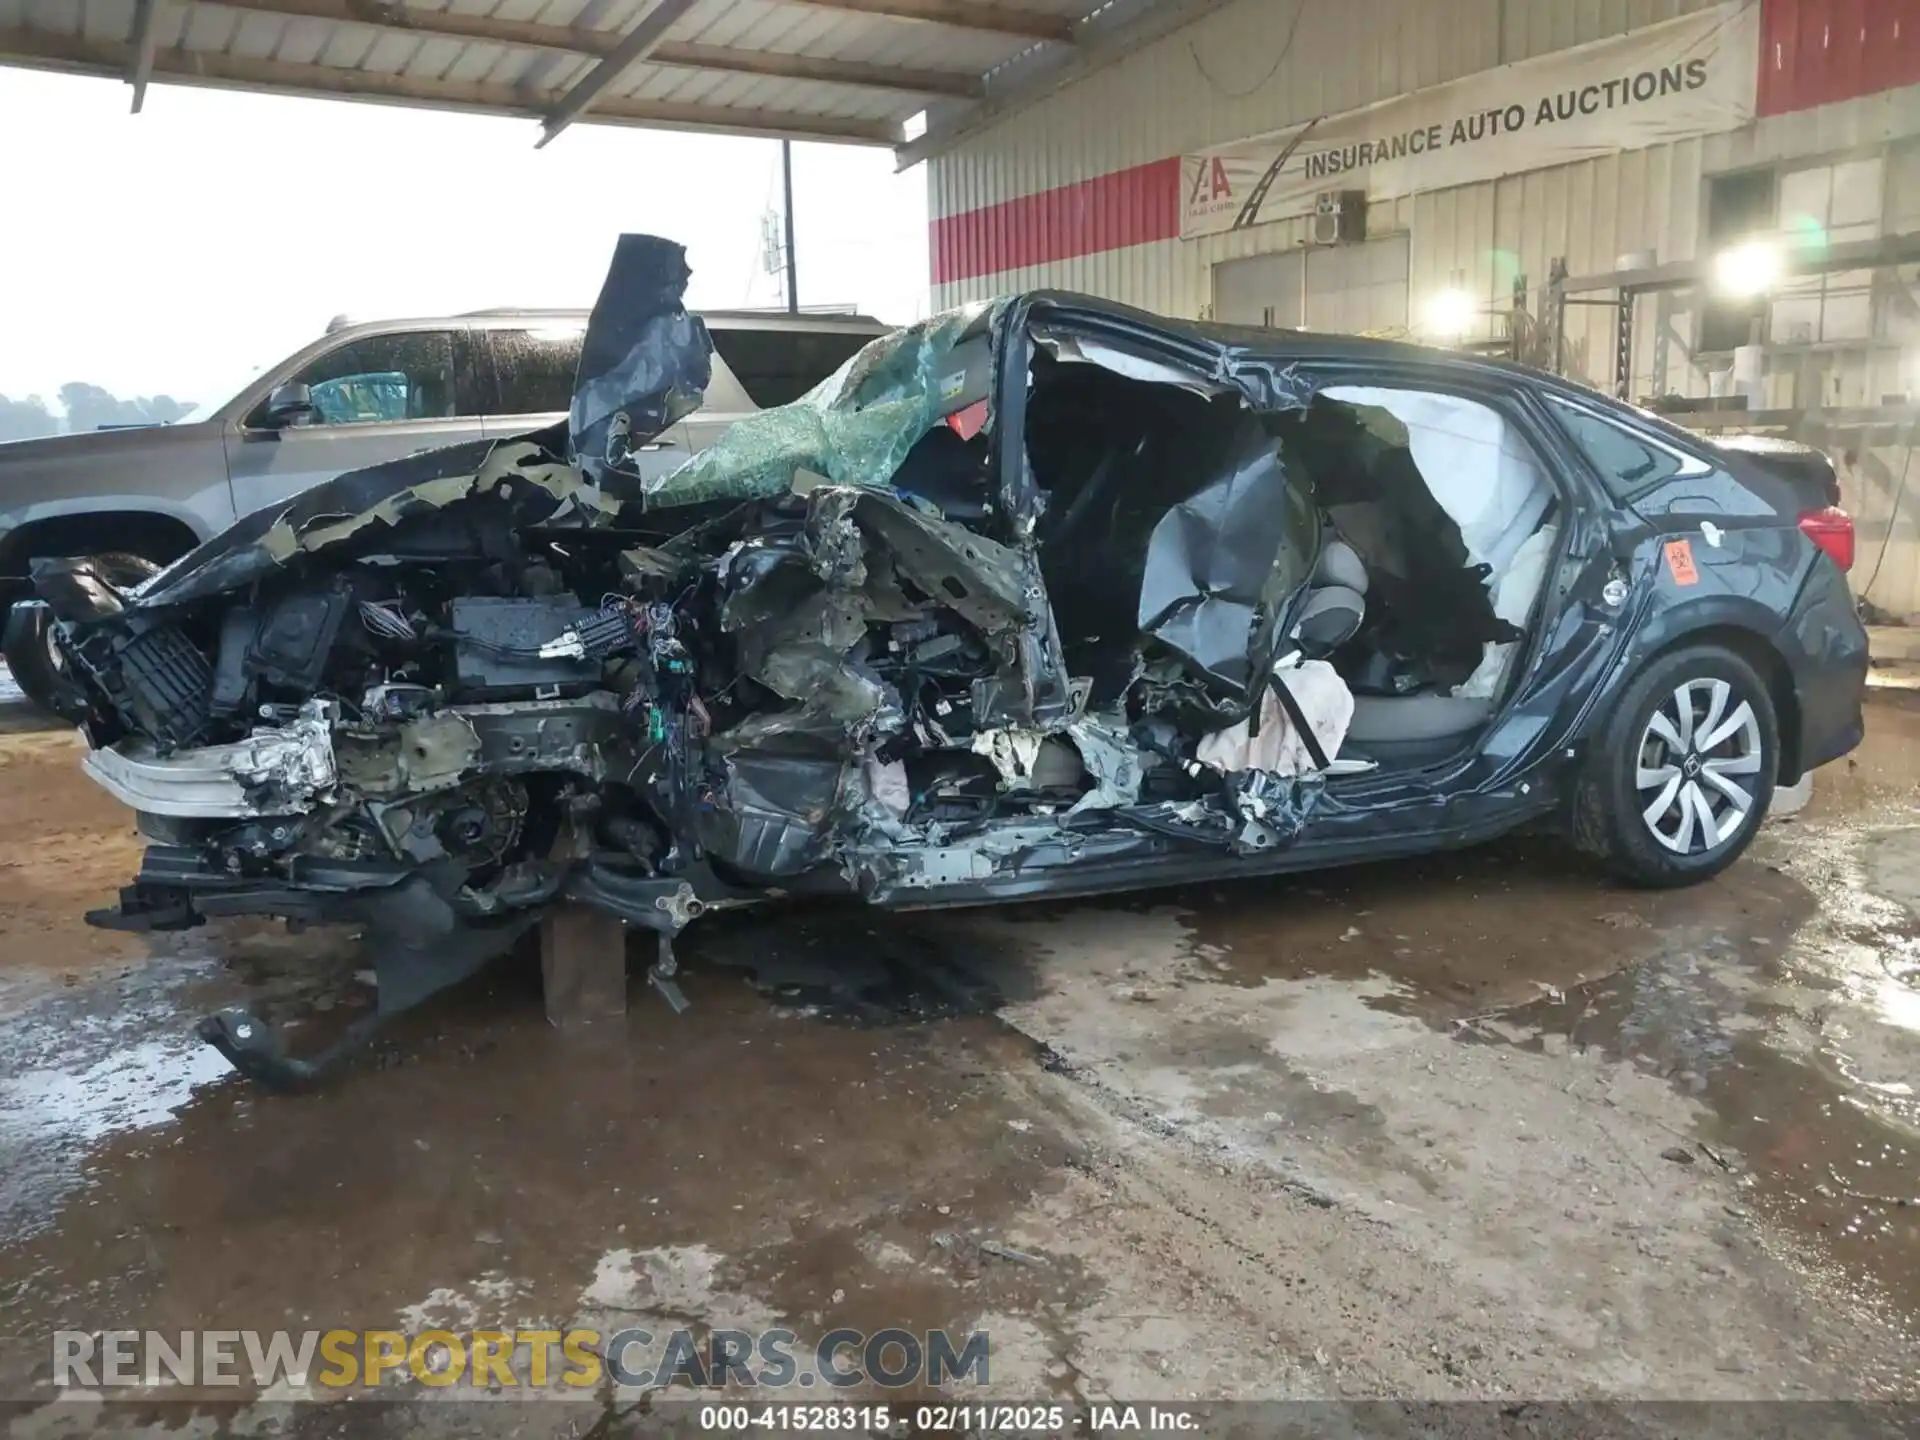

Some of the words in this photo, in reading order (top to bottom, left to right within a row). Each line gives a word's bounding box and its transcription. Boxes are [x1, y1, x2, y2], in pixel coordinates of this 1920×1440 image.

[1305, 124, 1442, 180] INSURANCE
[1450, 105, 1525, 146] AUTO
[1535, 59, 1708, 125] AUCTIONS
